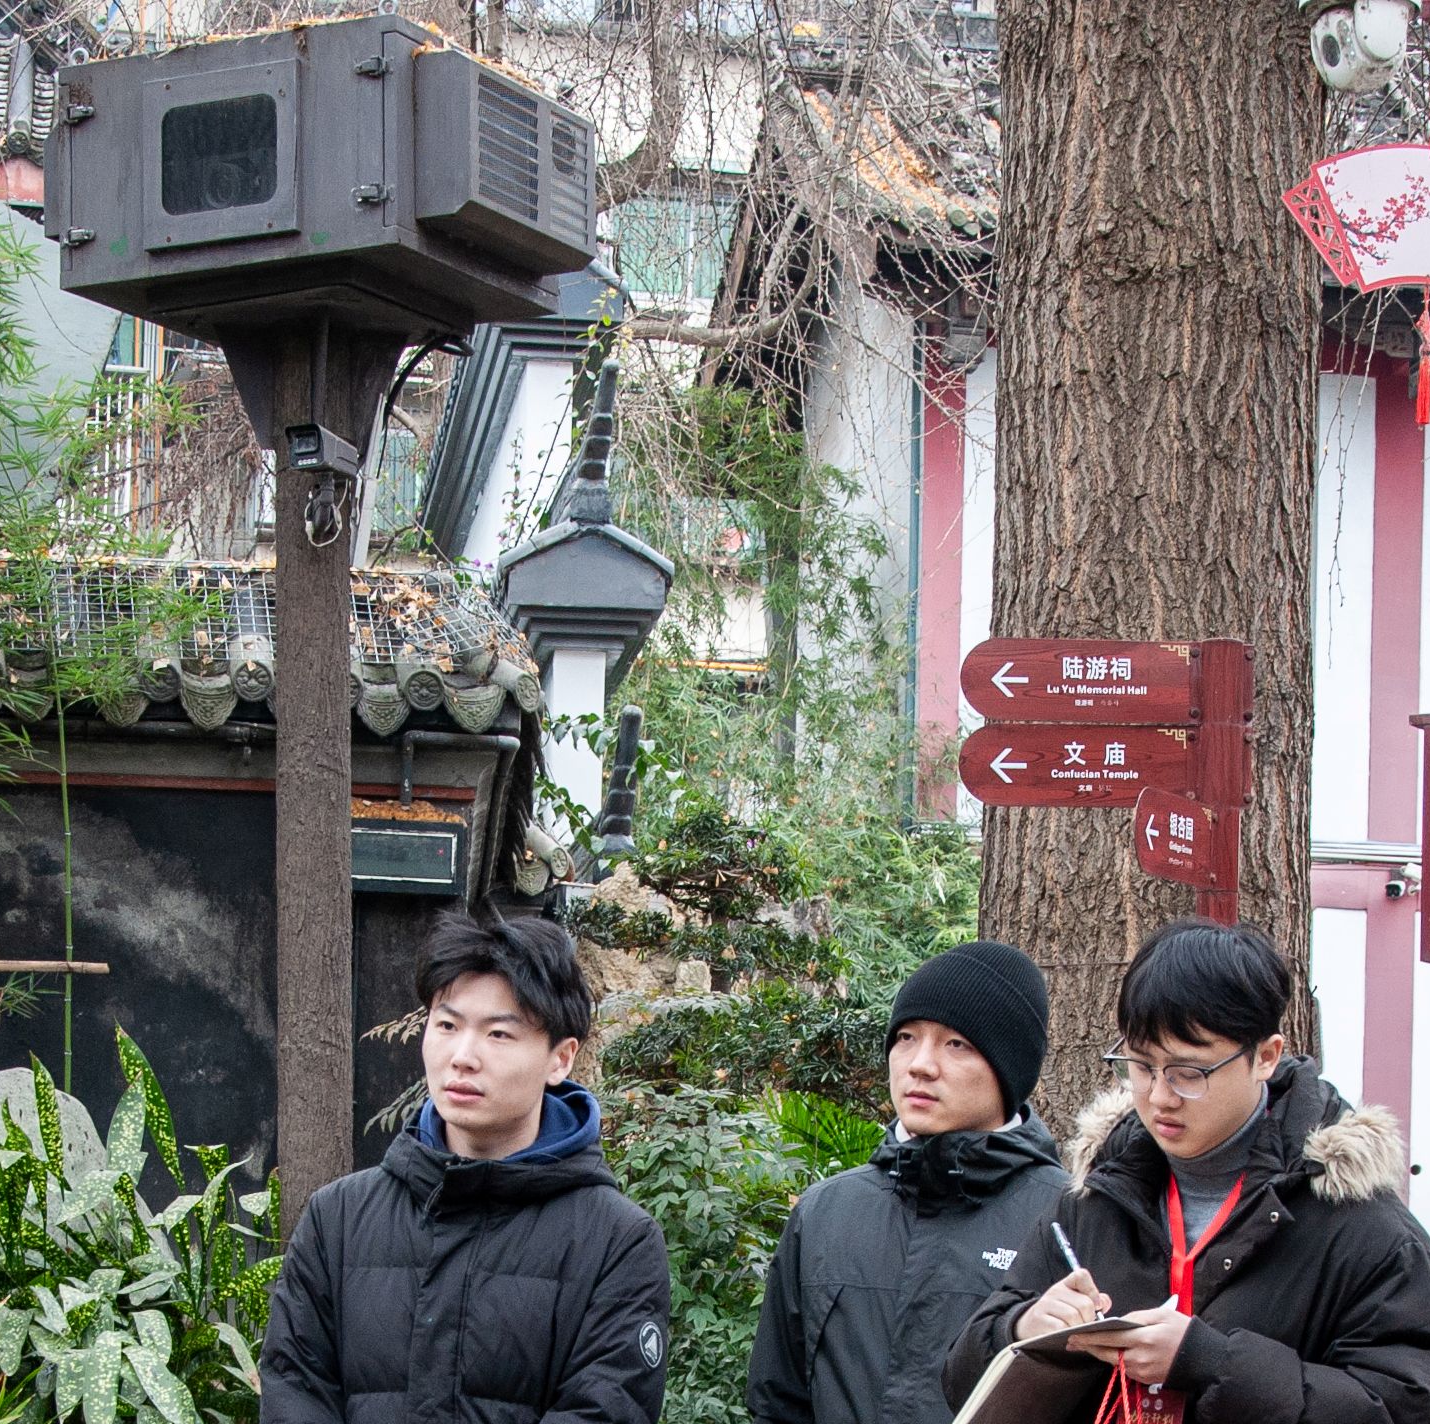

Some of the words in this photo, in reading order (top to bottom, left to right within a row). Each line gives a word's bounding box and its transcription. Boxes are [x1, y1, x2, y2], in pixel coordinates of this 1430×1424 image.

[1062, 656, 1132, 681] 陆游祠
[1046, 684, 1060, 694] Lu
[1062, 684, 1075, 695] Yu
[1076, 684, 1126, 695] Memorial
[1127, 686, 1148, 695] Hall
[1063, 741, 1127, 766] 文庙
[1051, 768, 1101, 779] Confucian
[1102, 769, 1139, 780] Temple
